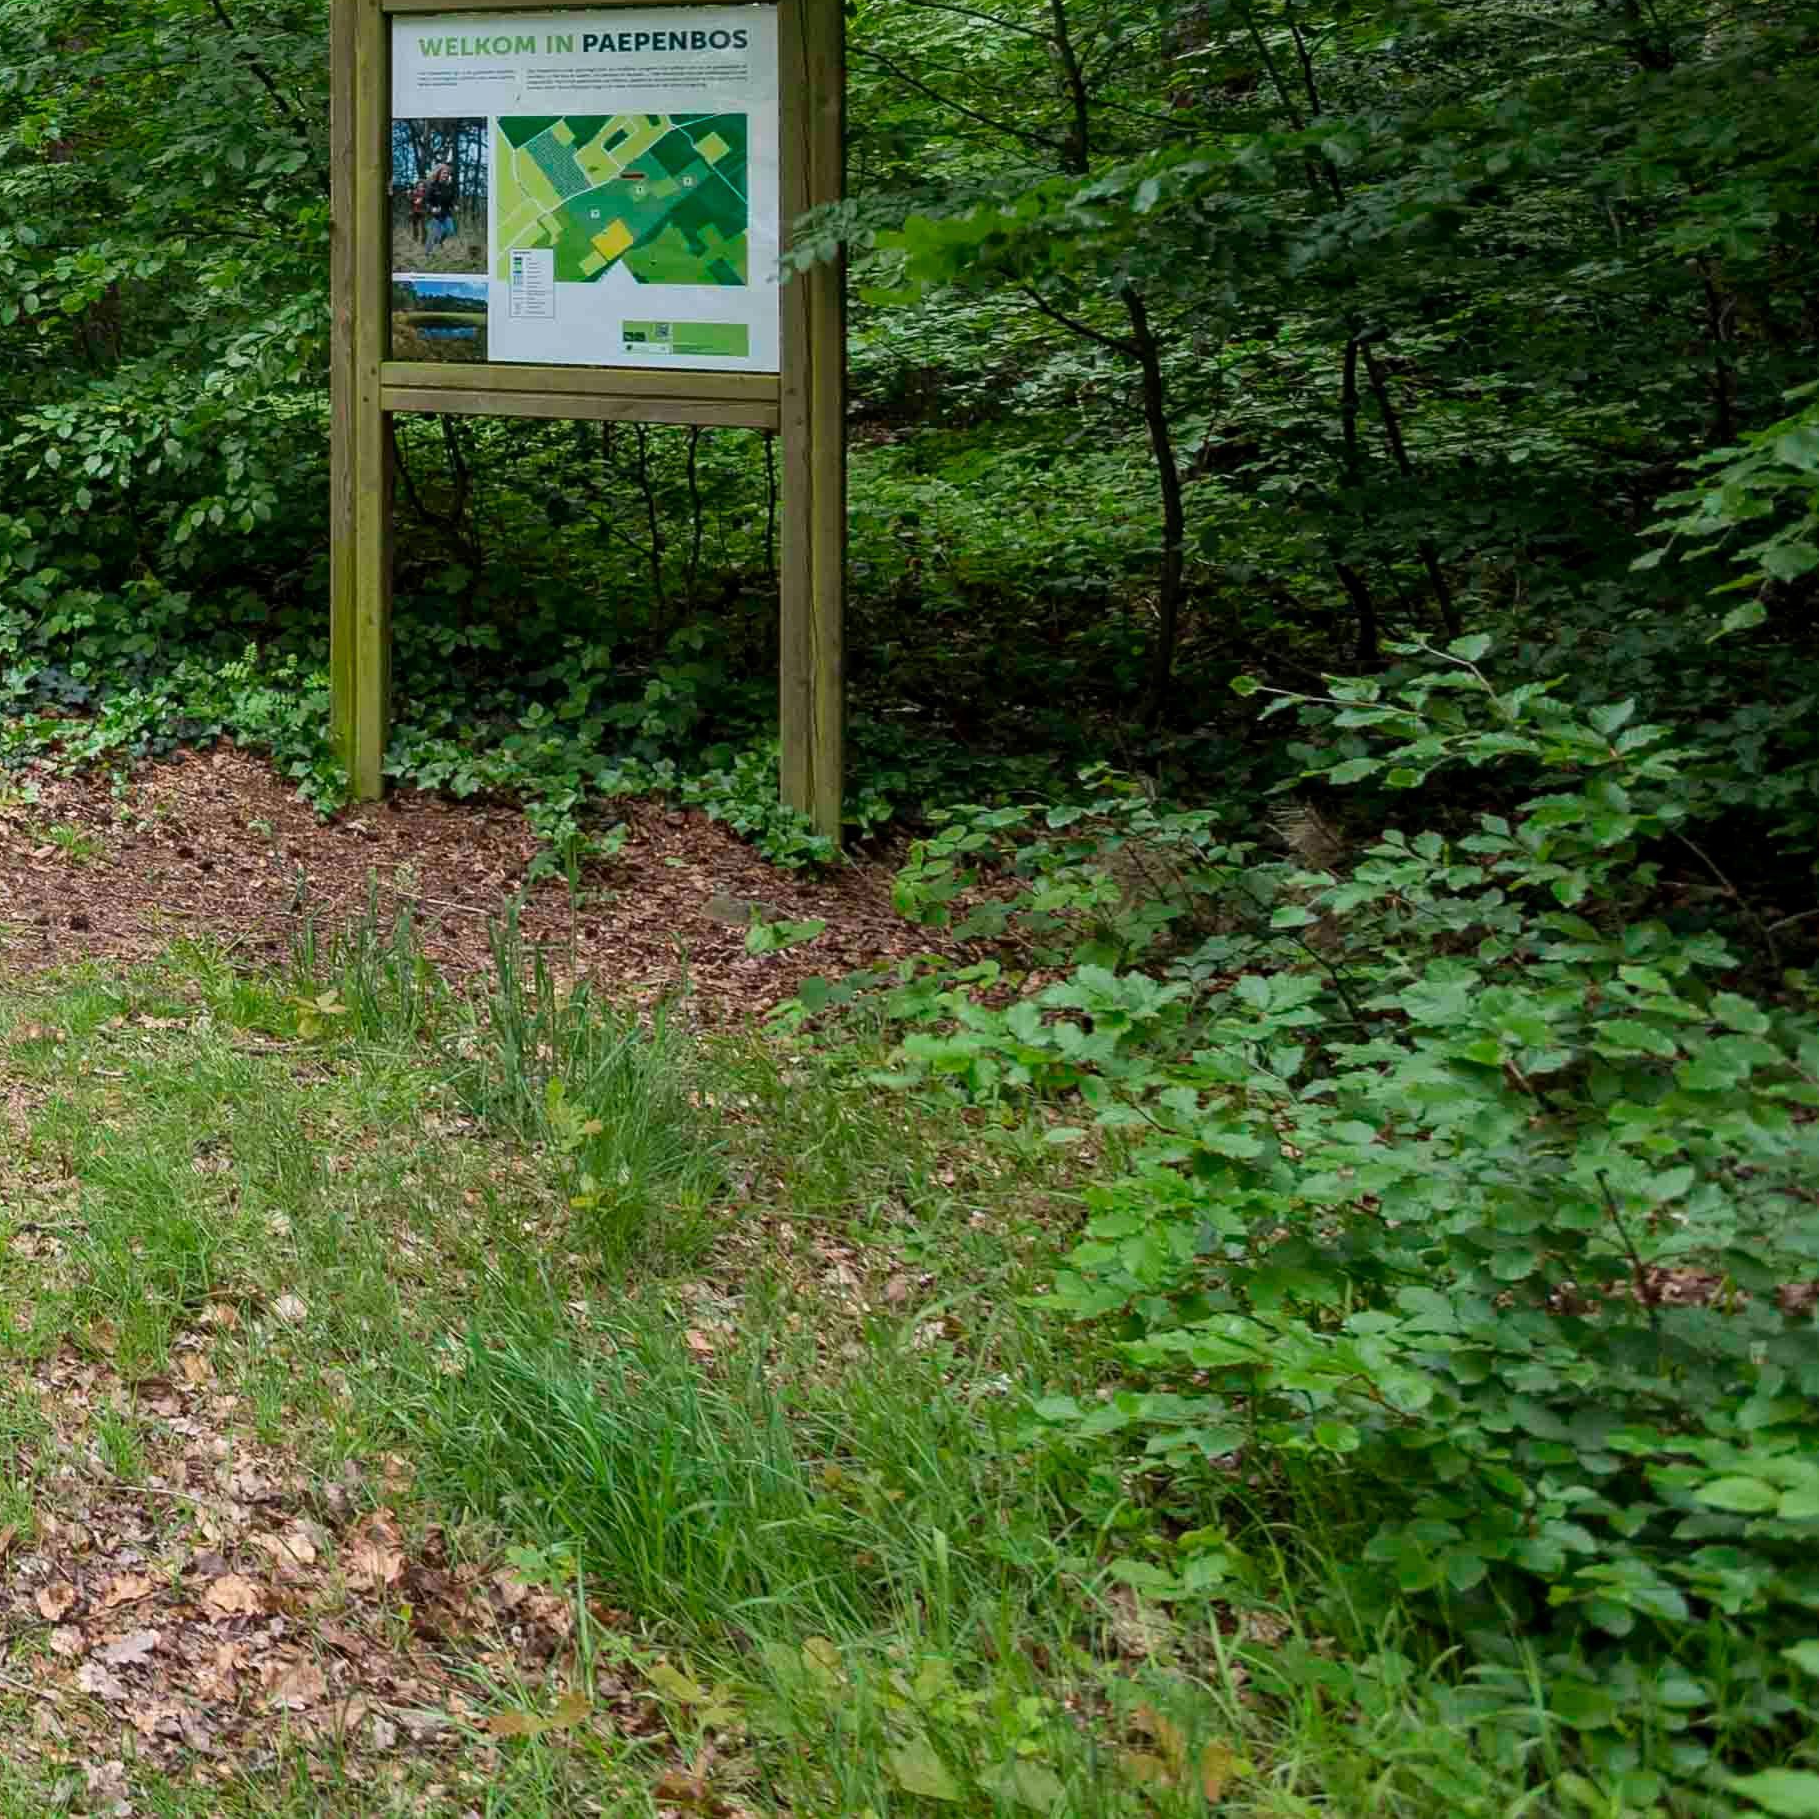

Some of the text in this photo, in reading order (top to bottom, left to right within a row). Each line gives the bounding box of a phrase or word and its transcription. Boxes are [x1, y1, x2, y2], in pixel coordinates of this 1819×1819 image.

[418, 30, 748, 56] WELKOM IN PAEPENBOS
